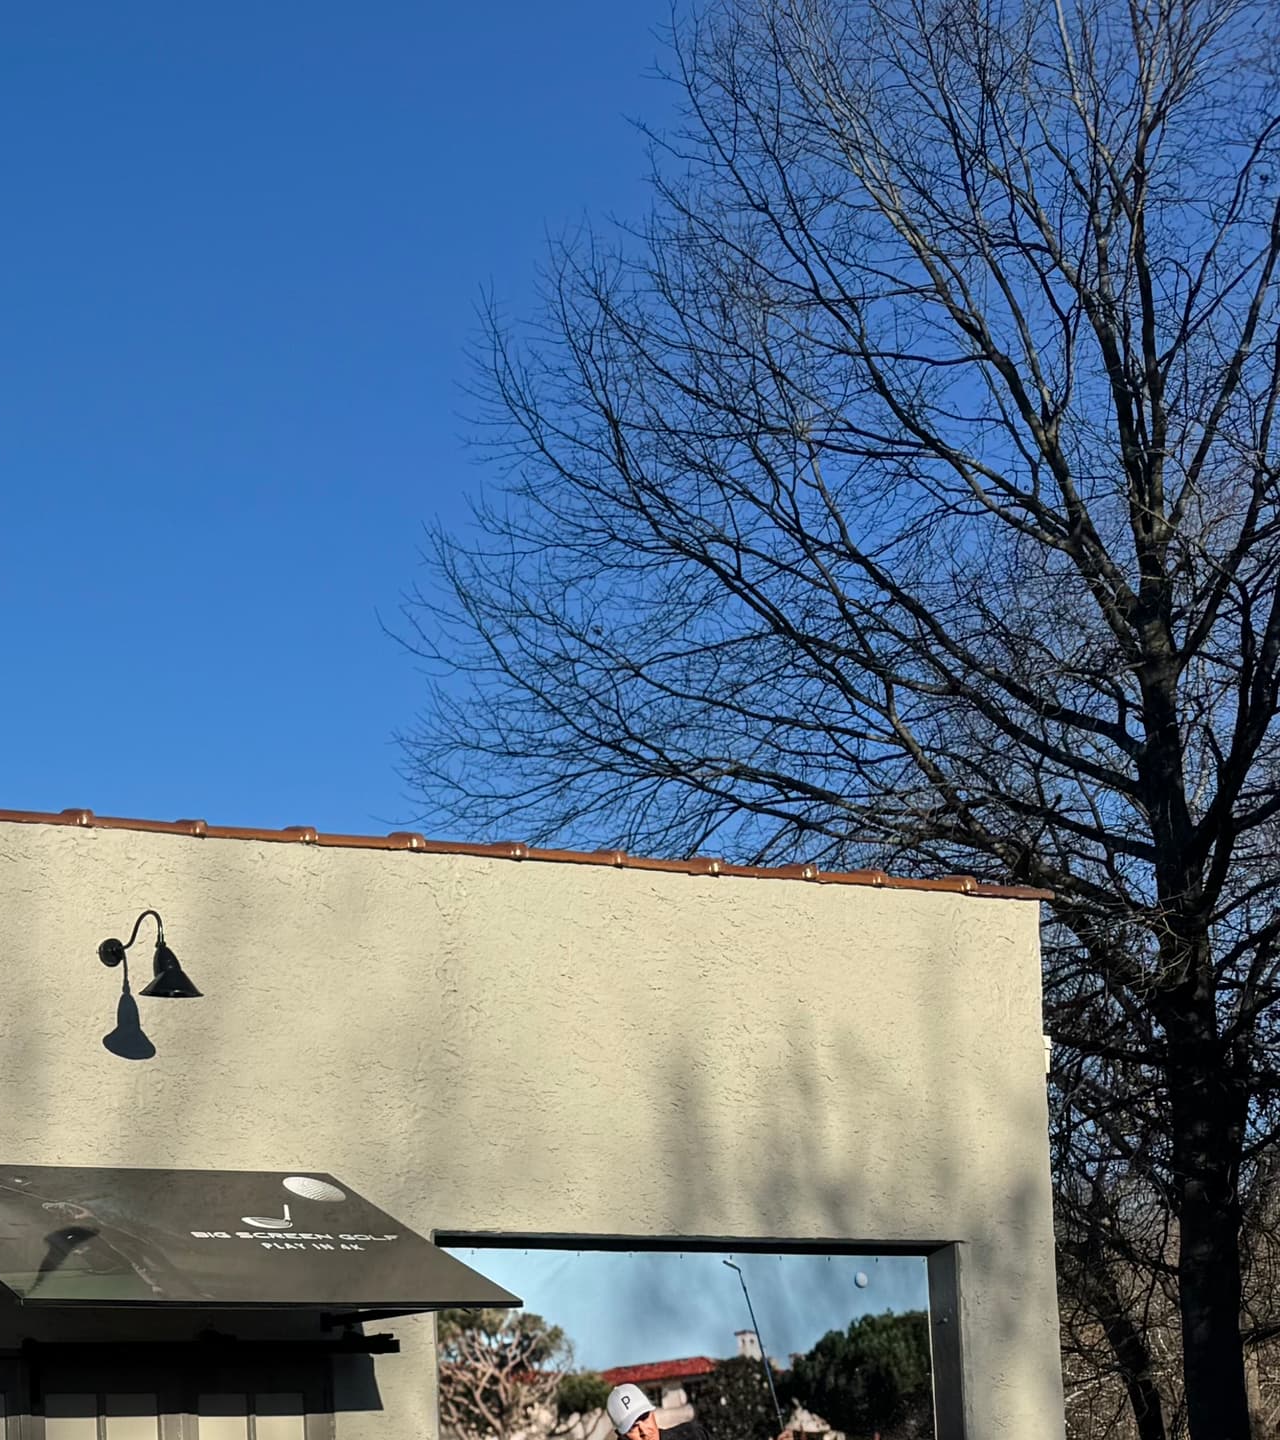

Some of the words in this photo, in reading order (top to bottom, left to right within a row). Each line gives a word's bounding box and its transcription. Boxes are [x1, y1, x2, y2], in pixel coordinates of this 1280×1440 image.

[189, 1230, 232, 1240] BIG
[234, 1230, 335, 1241] SCREEN
[337, 1232, 400, 1242] GOLF
[260, 1241, 307, 1251] PLAY
[311, 1242, 335, 1251] IN
[339, 1242, 366, 1252] 4K
